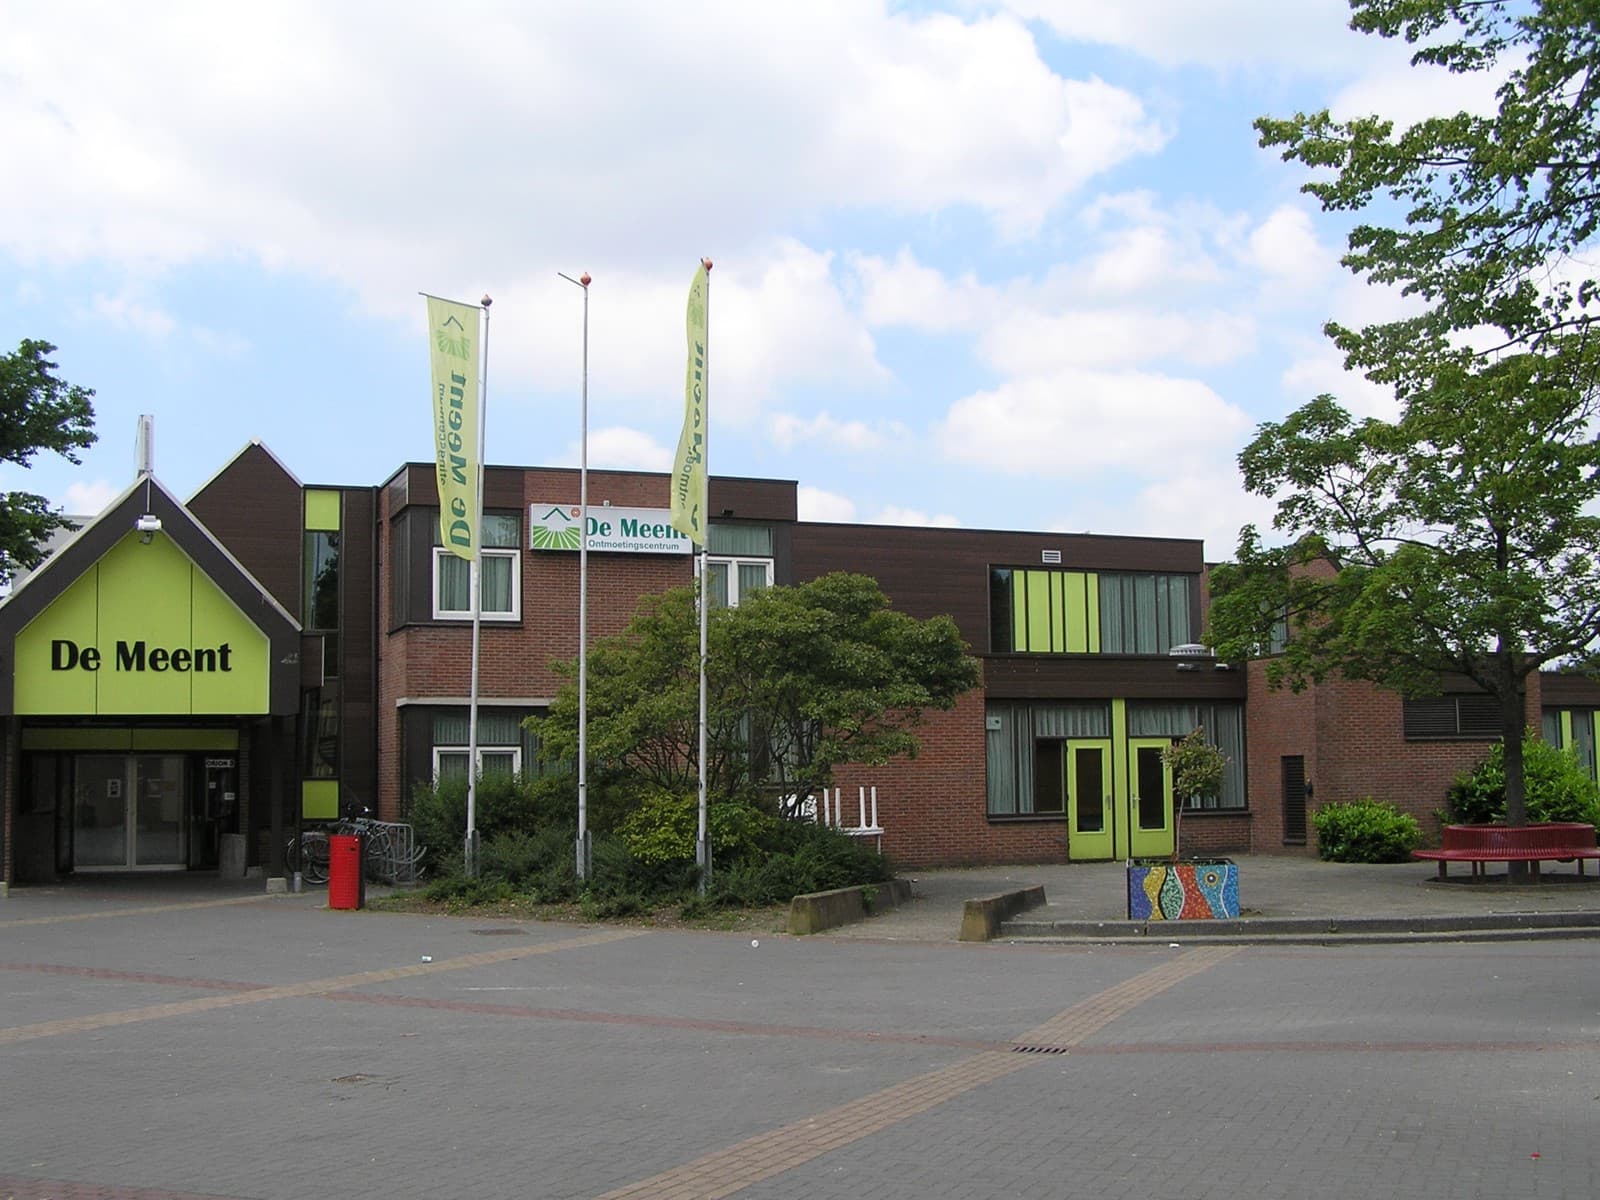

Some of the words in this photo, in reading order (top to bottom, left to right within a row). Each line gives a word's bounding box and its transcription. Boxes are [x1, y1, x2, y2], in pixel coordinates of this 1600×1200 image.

[585, 516, 612, 537] De
[588, 539, 680, 550] Ontmoetingscentrum
[51, 640, 101, 671] De
[116, 641, 232, 672] Meent
